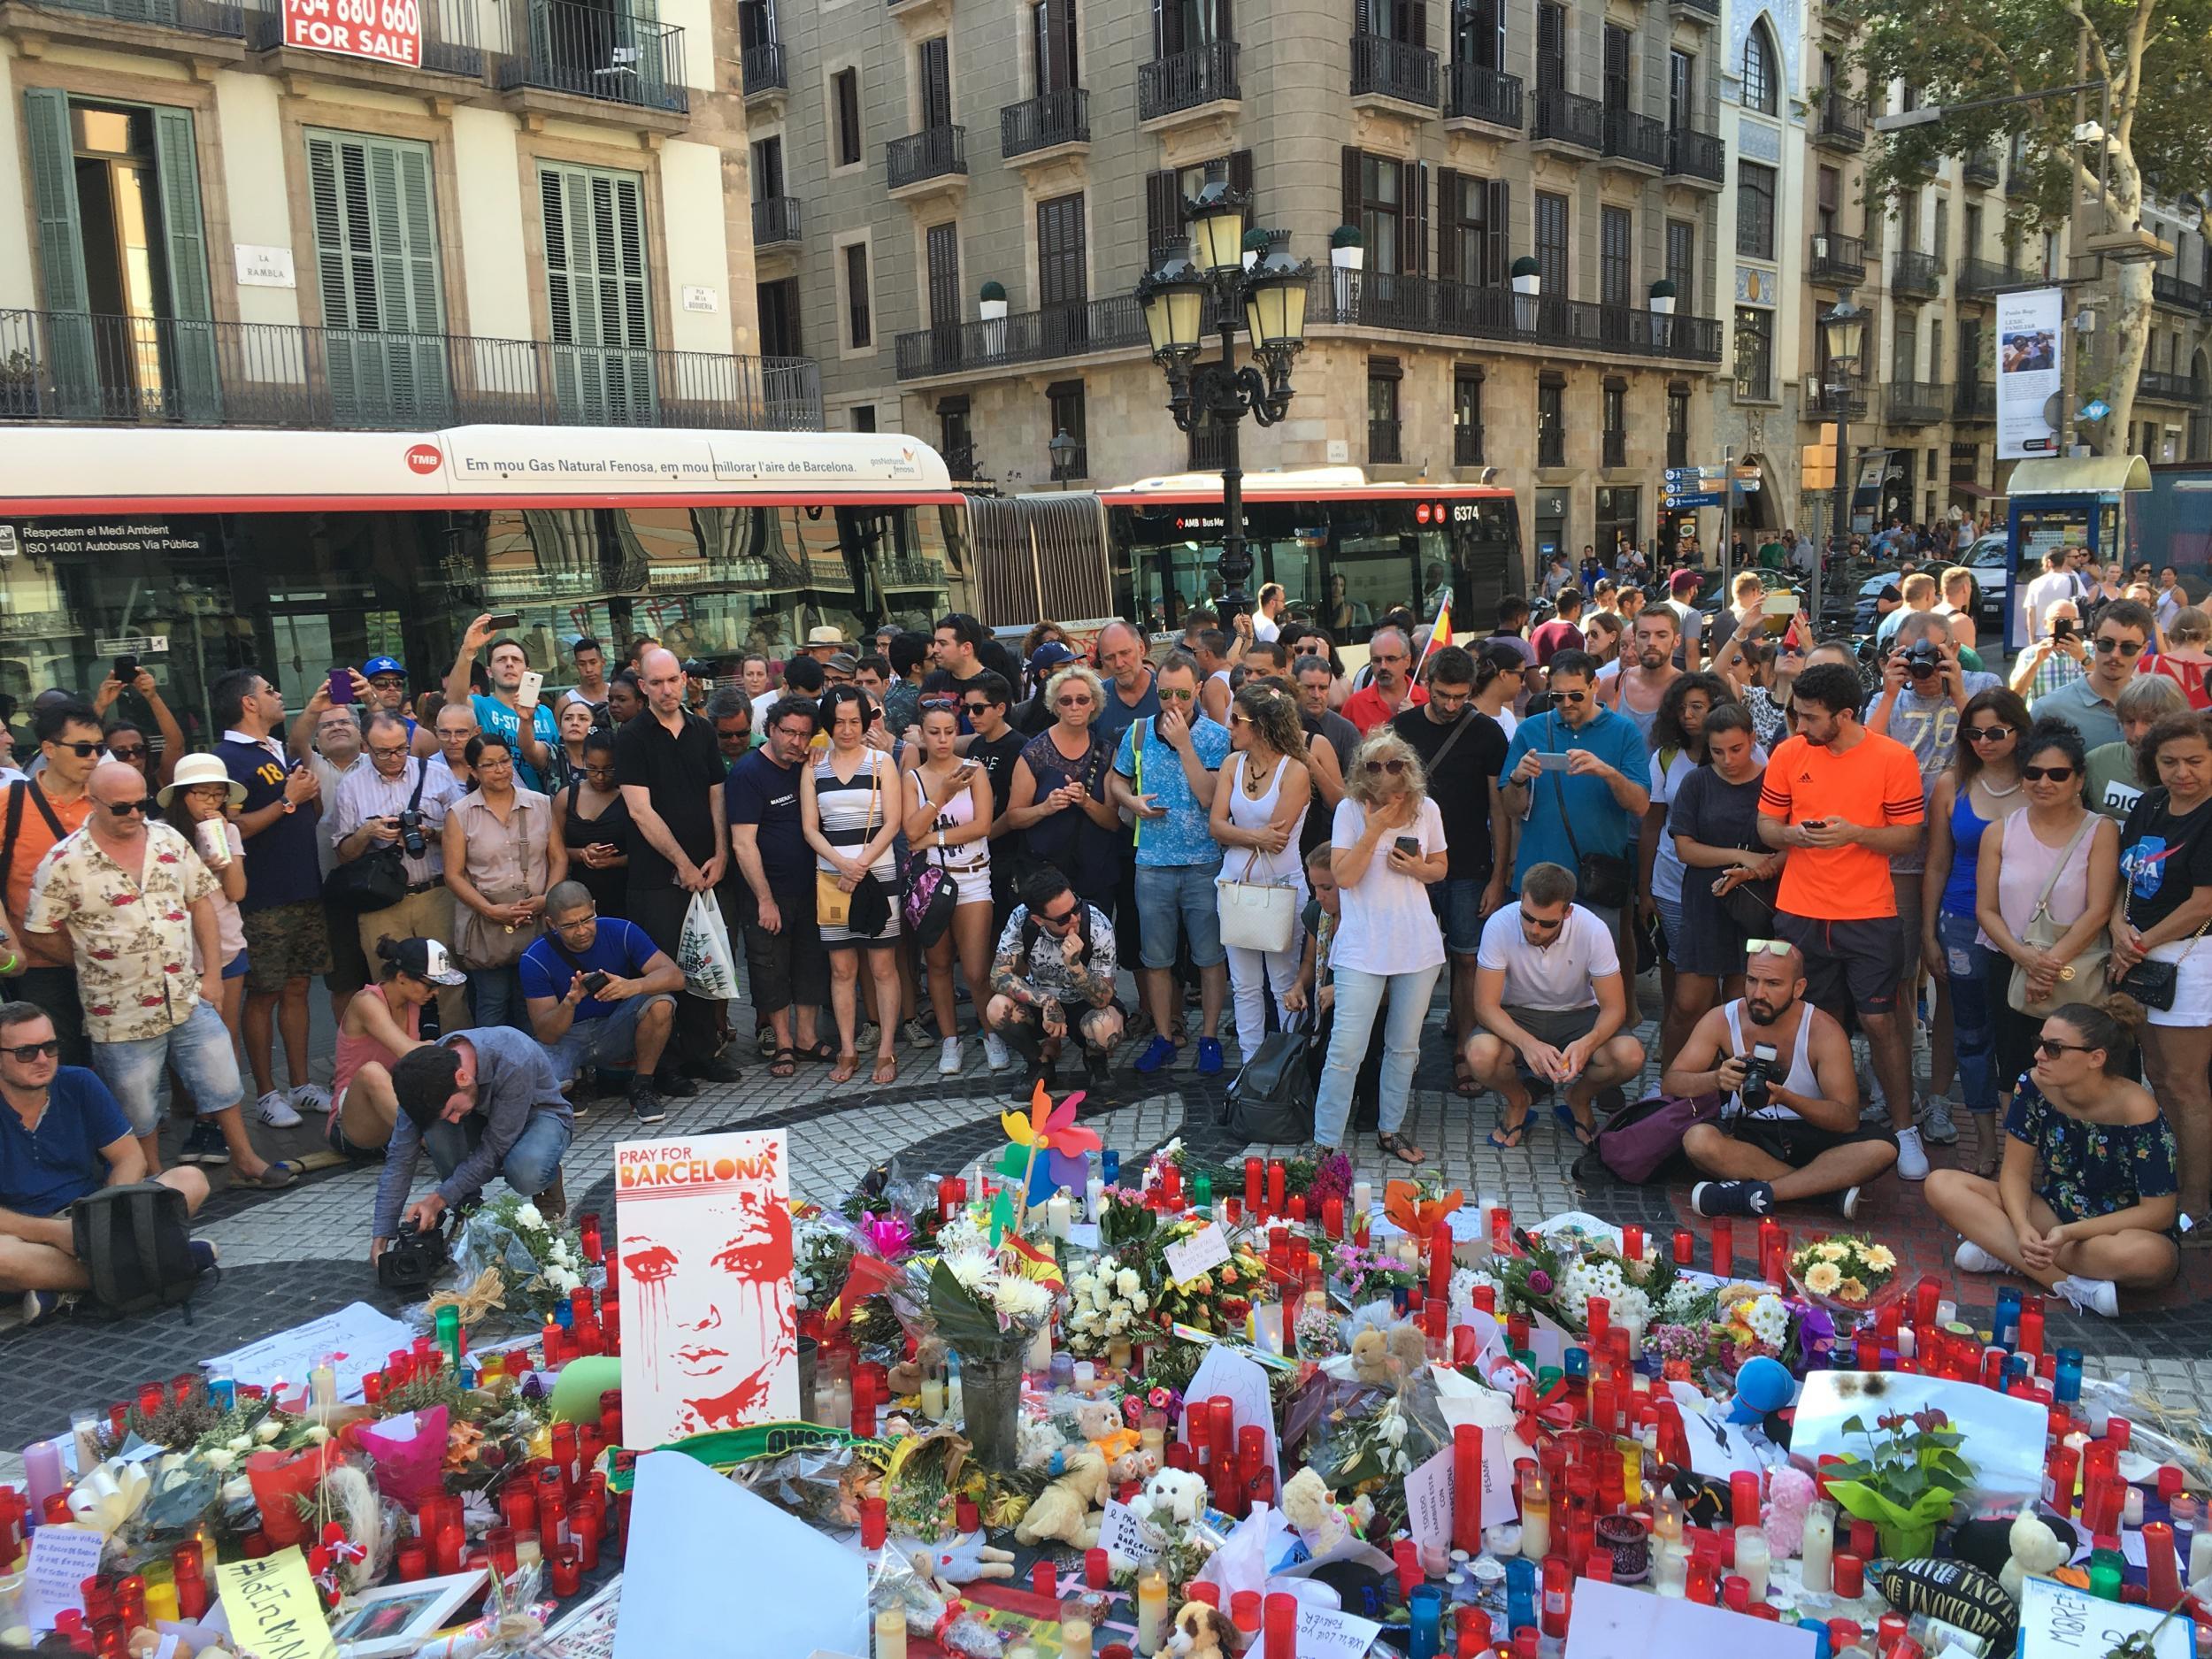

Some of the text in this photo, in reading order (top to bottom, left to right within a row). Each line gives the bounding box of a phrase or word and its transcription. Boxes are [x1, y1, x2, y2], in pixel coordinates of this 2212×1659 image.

[295, 19, 413, 61] FOR SALE
[257, 254, 269, 263] LA
[247, 267, 285, 278] RAMBLA
[411, 454, 438, 465] TMB
[466, 457, 857, 474] Em mou Gas Natural Fenosa, em mou millorar l'aire de Barcelona.
[1454, 505, 1479, 522] 6374
[1185, 518, 1200, 528] AMB
[1202, 517, 1214, 527] Bus
[23, 525, 170, 539] Respectem el Medi Ambient
[26, 542, 47, 554] ISO
[50, 541, 83, 553] 14001
[86, 541, 142, 551] Autobusos
[162, 539, 200, 550] Pública
[1903, 706, 1960, 751] 76
[256, 763, 285, 786] 18
[619, 1147, 692, 1164] PRAY FOR
[620, 1156, 777, 1188] BARCELONA
[1482, 1458, 1493, 1494] PÉSAME
[1118, 1524, 1136, 1537] FOR
